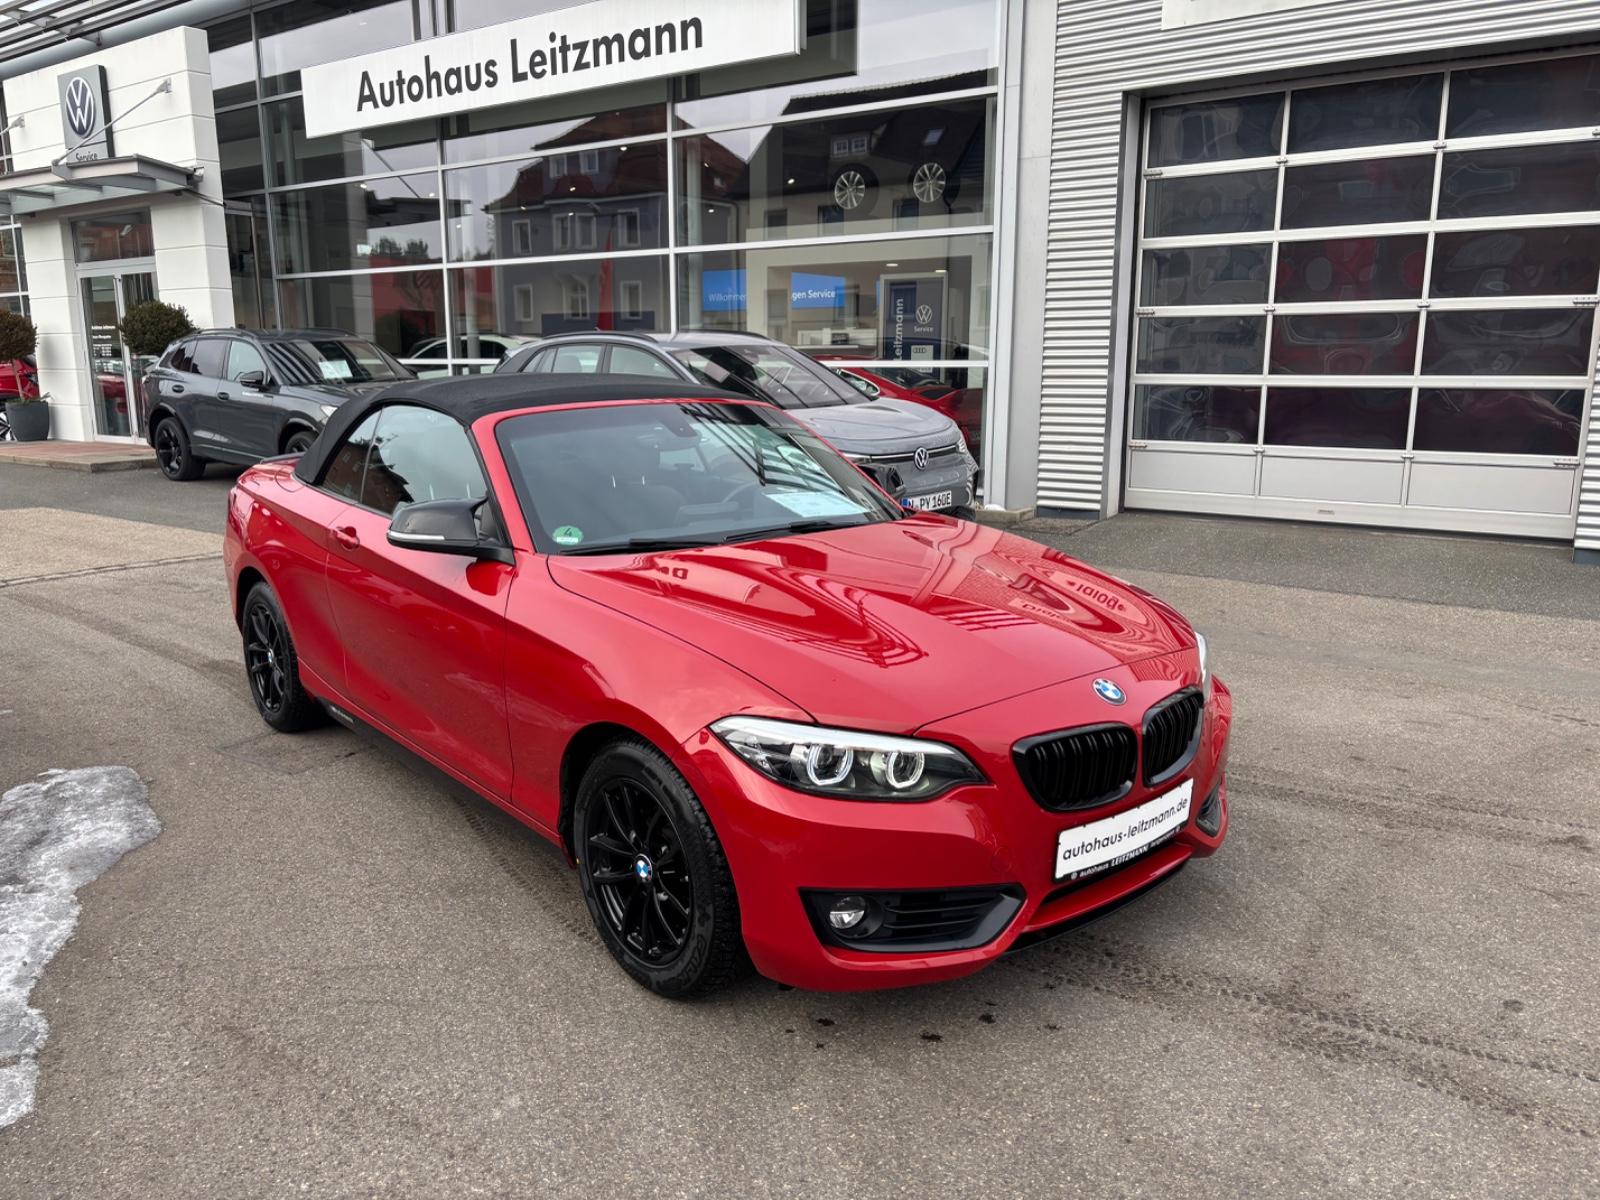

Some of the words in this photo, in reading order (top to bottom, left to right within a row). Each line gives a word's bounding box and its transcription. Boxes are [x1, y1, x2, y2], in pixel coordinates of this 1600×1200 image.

[356, 54, 499, 112] Autohaus
[509, 16, 704, 83] Leitzmann
[807, 288, 836, 299] Service
[920, 496, 931, 510] PY
[563, 527, 572, 537] 4
[1062, 798, 1189, 861] autohaus-leitzmann.de
[1111, 846, 1149, 867] LEITZMANN
